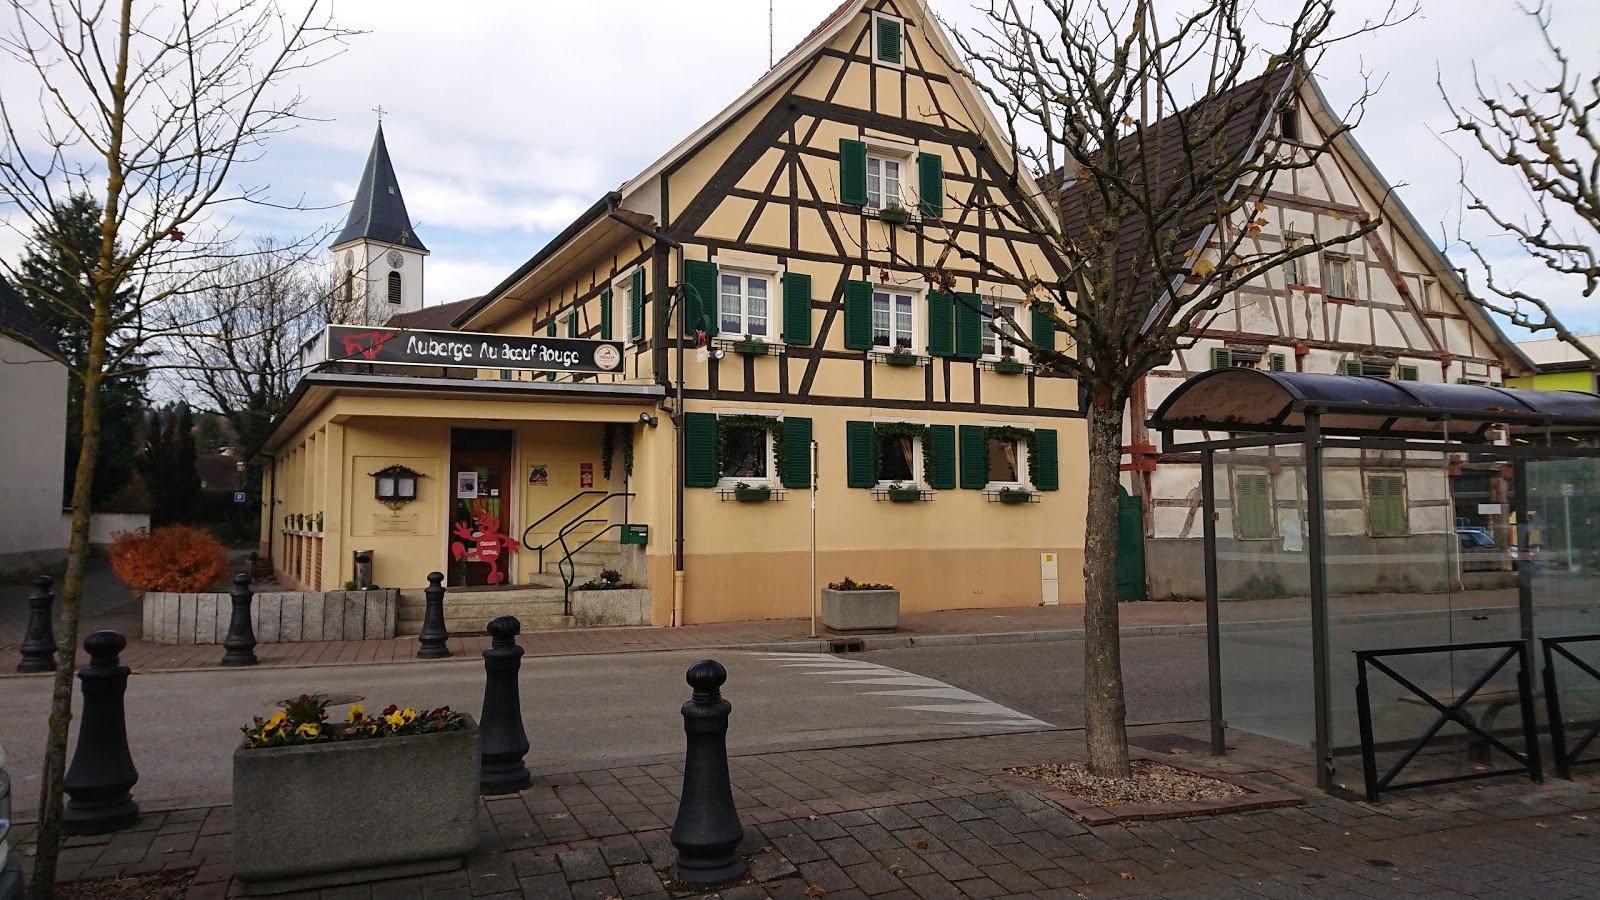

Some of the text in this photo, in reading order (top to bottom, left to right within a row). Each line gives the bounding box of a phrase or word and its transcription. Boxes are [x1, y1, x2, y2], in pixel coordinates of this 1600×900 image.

[406, 335, 473, 361] Auberge
[479, 342, 498, 359] Au
[539, 345, 579, 367] Rouge
